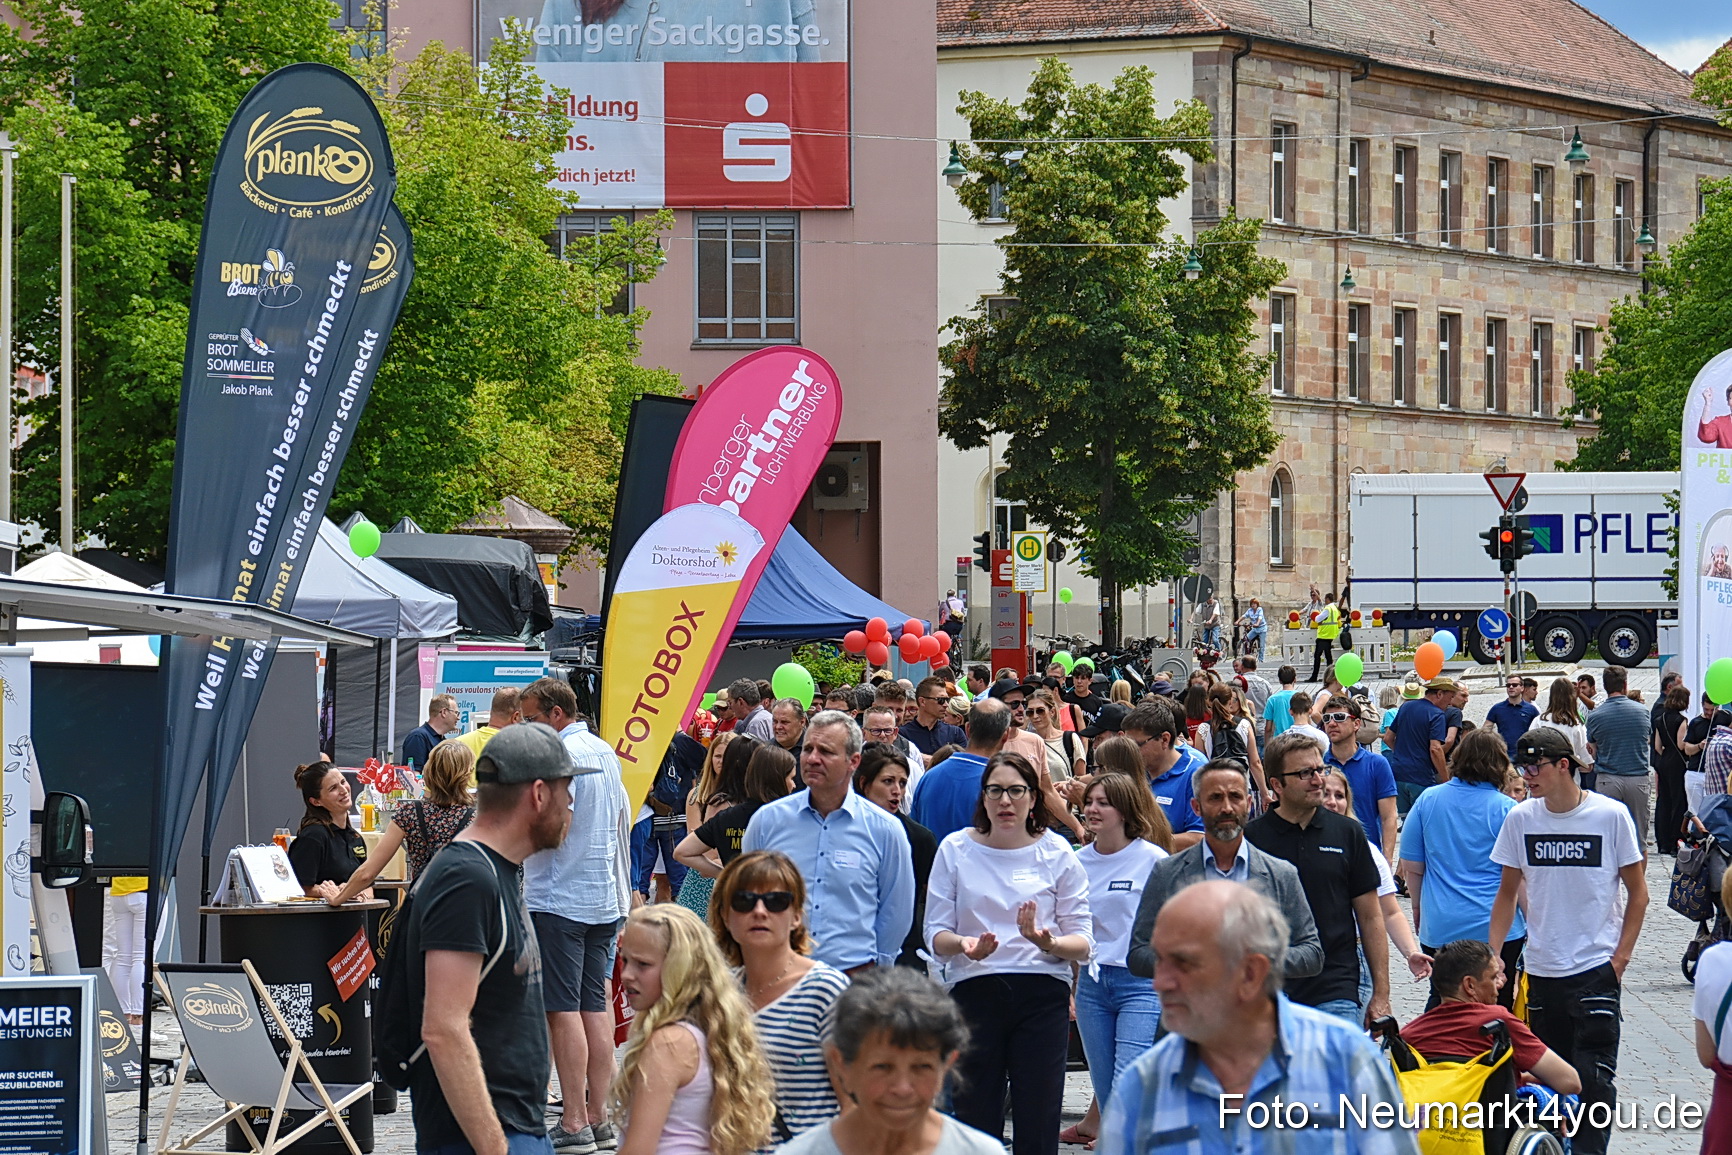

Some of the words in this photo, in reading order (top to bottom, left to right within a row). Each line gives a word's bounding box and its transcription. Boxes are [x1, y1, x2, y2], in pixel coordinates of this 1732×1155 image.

[499, 16, 641, 54] Weniger
[648, 16, 831, 54] Sackgasse.
[256, 140, 335, 183] plank
[557, 168, 590, 183] dich
[592, 168, 637, 186] jetzt!
[239, 180, 279, 215] Bäckerei
[289, 206, 314, 219] Café
[324, 182, 376, 217] Konditorei
[221, 262, 262, 285] BROT
[359, 267, 399, 295] onditorei
[226, 278, 258, 297] Biene
[208, 332, 240, 341] GEPRÜFTER
[207, 342, 238, 357] BROT
[206, 357, 275, 373] SOMMELIER
[221, 383, 247, 396] Jakob
[249, 384, 273, 397] Plank
[760, 381, 828, 486] LICHTWERBUNG
[286, 486, 320, 561] einfach
[309, 419, 343, 487] besser
[337, 327, 379, 421] schmeckt
[194, 652, 228, 711] Weil
[247, 458, 286, 557] einfach
[272, 377, 312, 462] besser
[304, 258, 352, 378] schmeckt
[1574, 512, 1680, 554] PFLE
[652, 544, 670, 552] Alten-
[682, 546, 711, 555] Pflegeheim
[651, 552, 720, 569] Doktorshof
[445, 686, 464, 694] Nous
[464, 685, 492, 694] voulons
[615, 599, 706, 764] FOTOBOX
[457, 700, 476, 709] ollen
[725, 827, 736, 837] Wir
[331, 962, 342, 975] Wir
[341, 946, 358, 966] suchen
[0, 1006, 72, 1027] MEIER
[0, 1027, 72, 1040] EISTUNGEN
[17, 1071, 54, 1080] SUCHEN
[249, 1108, 270, 1119] BROT
